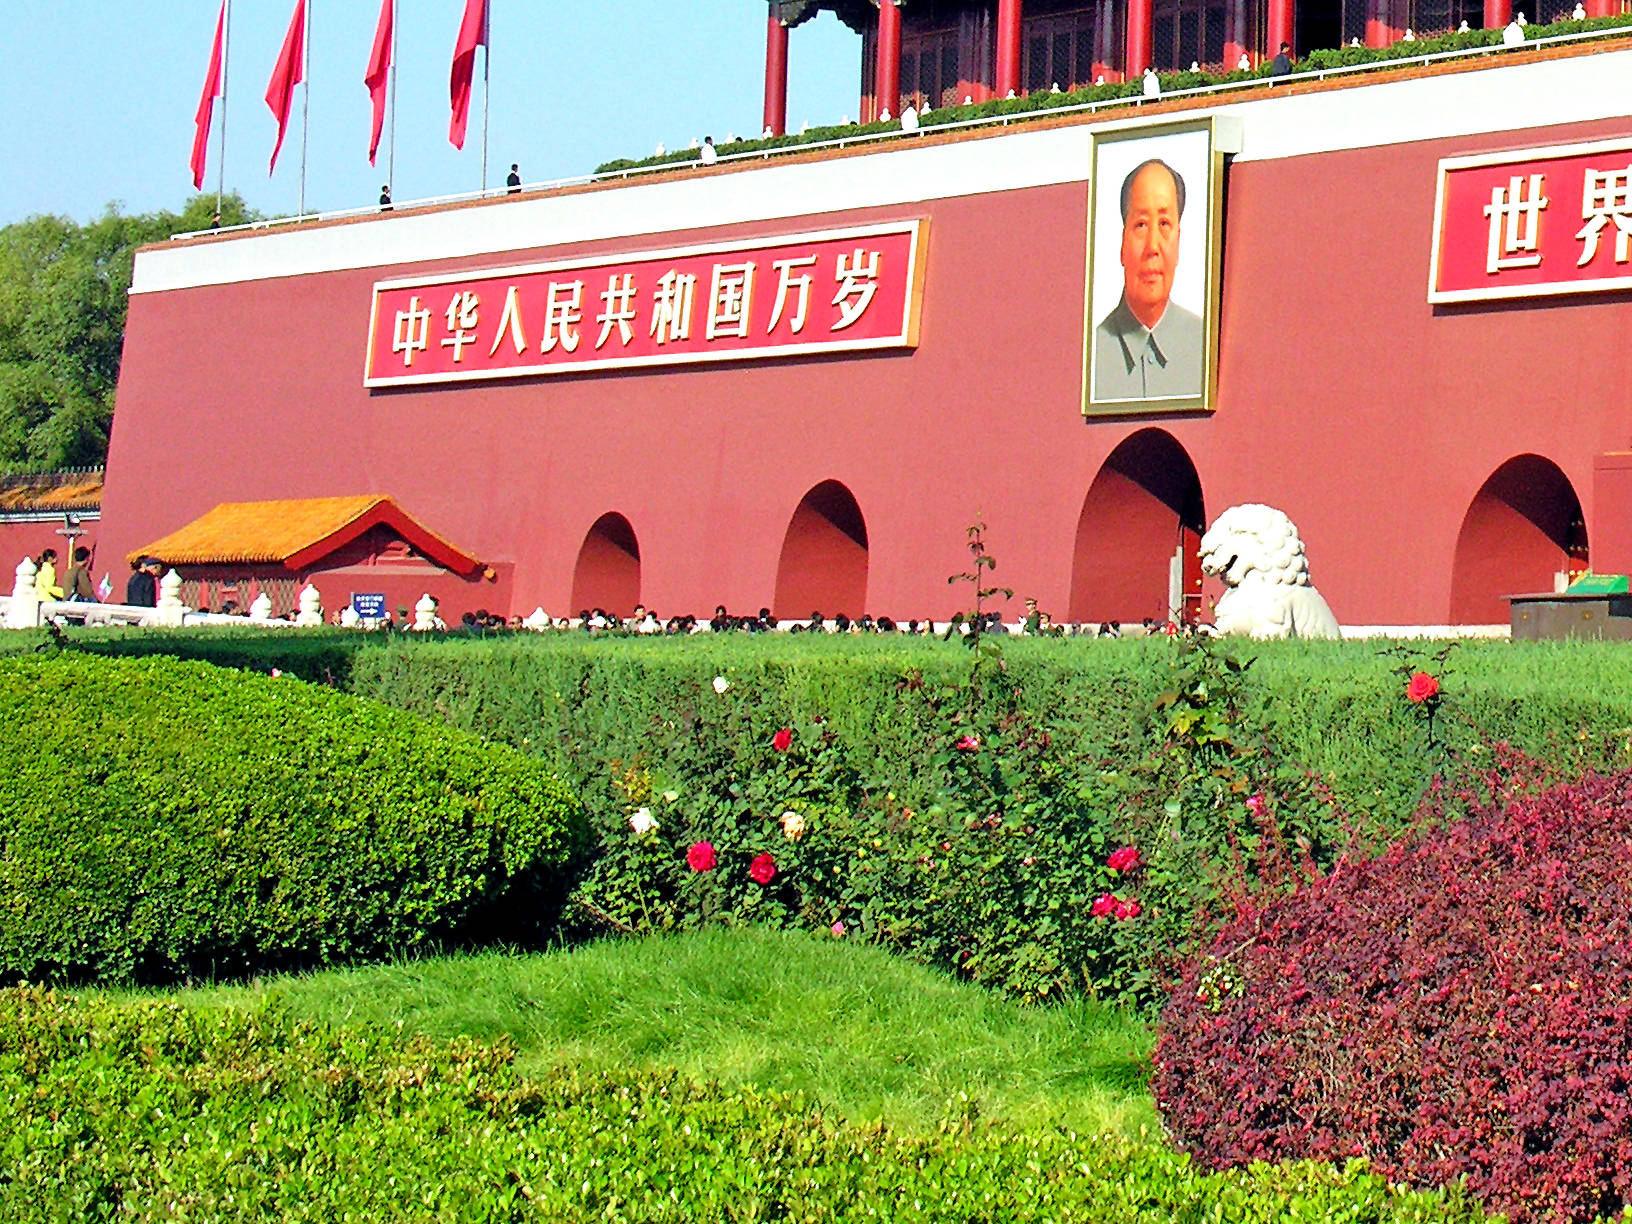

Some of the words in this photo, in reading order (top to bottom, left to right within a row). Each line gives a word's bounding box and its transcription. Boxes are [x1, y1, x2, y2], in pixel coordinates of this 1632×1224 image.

[391, 249, 881, 366] 中华人民共和国万岁
